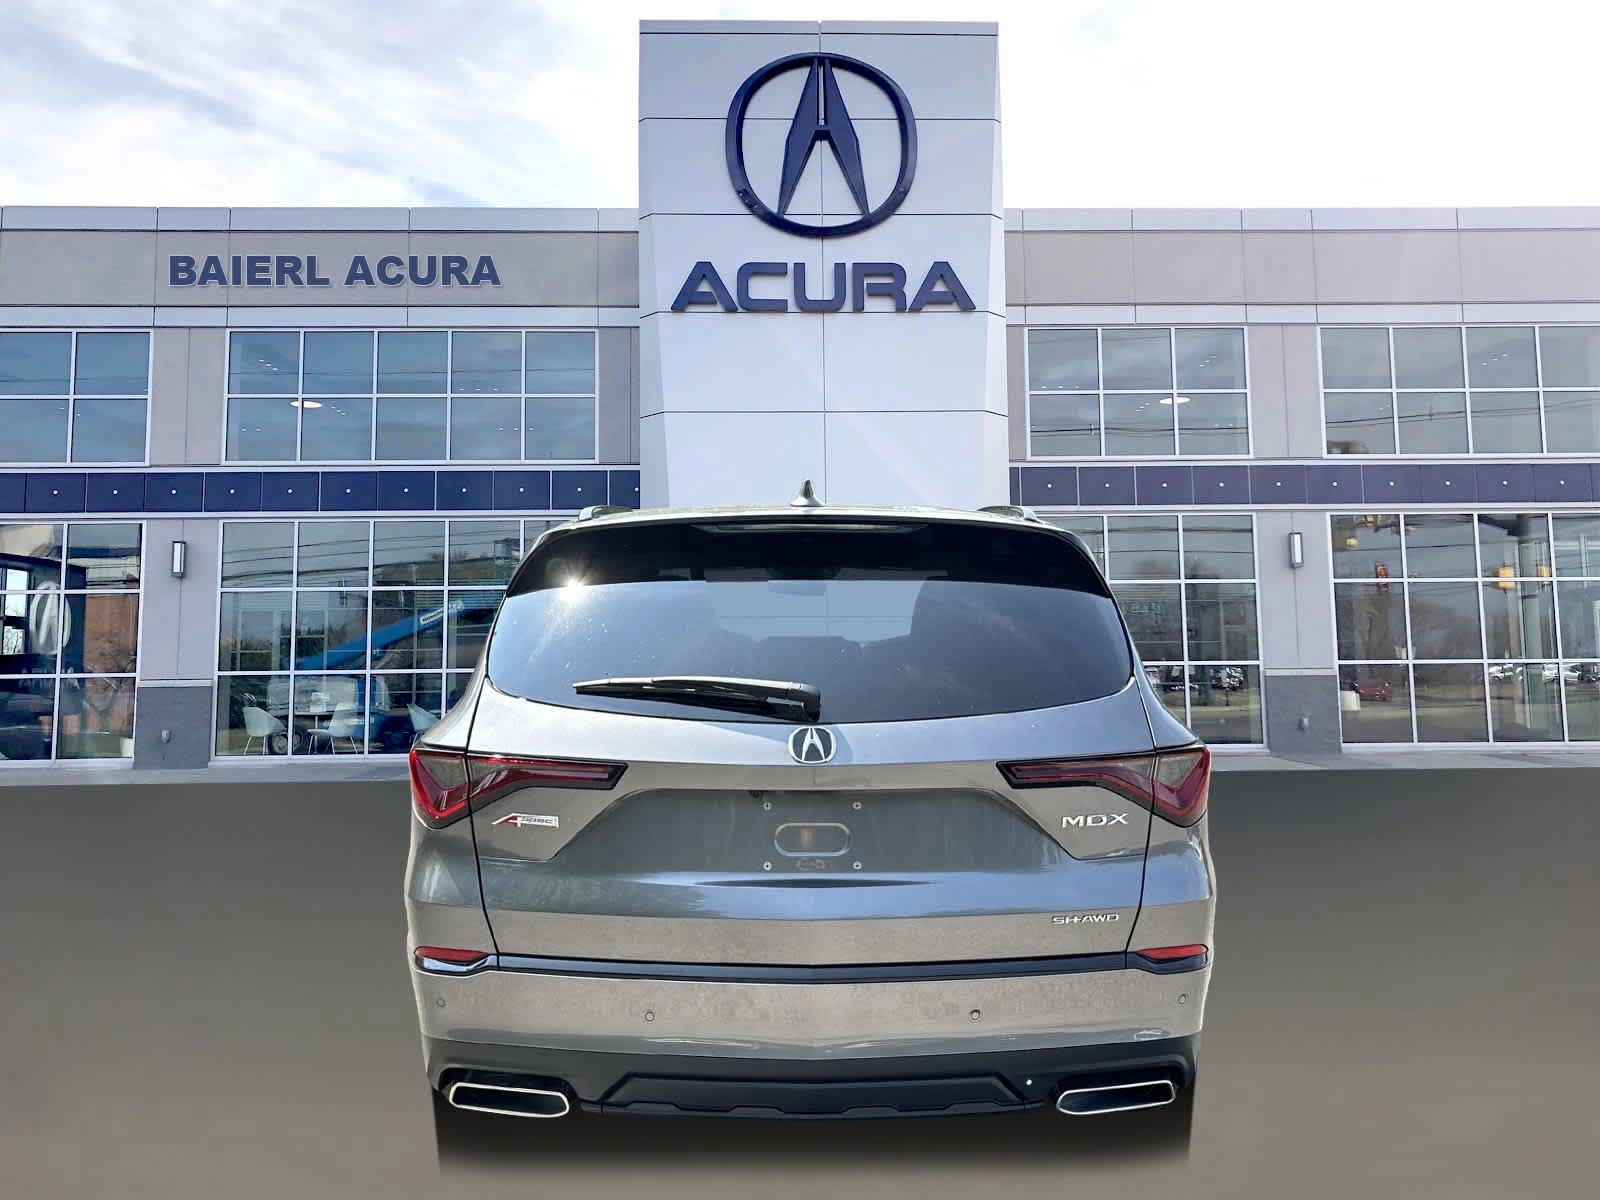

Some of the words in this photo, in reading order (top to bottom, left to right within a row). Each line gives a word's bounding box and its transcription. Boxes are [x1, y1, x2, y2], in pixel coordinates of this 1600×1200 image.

[169, 255, 330, 287] BAIERL
[344, 255, 502, 287] ACURA
[670, 261, 977, 313] ACURA
[1061, 813, 1129, 828] MDX
[1051, 914, 1120, 925] SH-AWD
